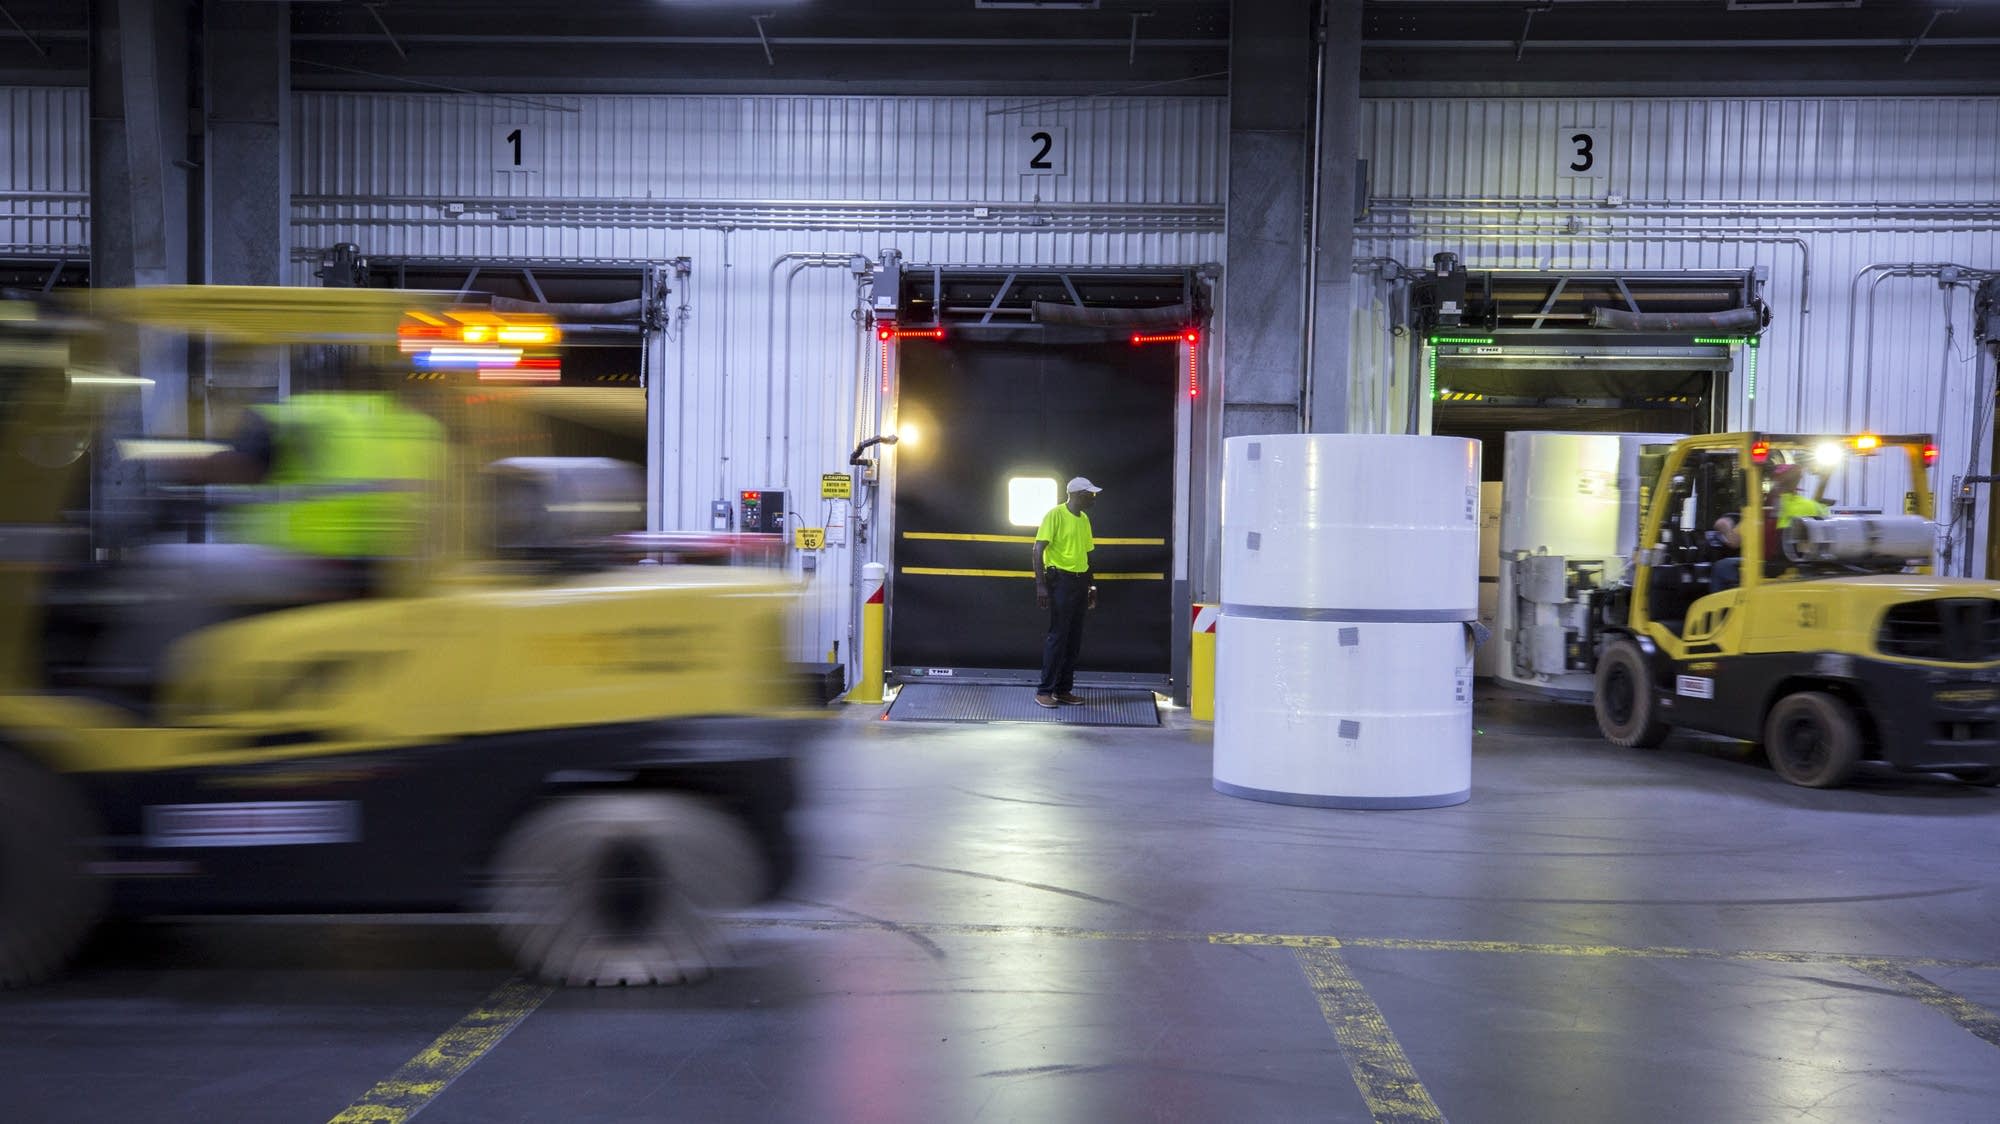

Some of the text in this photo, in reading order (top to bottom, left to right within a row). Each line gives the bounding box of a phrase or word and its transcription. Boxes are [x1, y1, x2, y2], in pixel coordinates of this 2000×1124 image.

[507, 129, 521, 165] 1
[1031, 132, 1052, 168] 2
[1570, 134, 1593, 171] 3
[804, 538, 816, 547] 45
